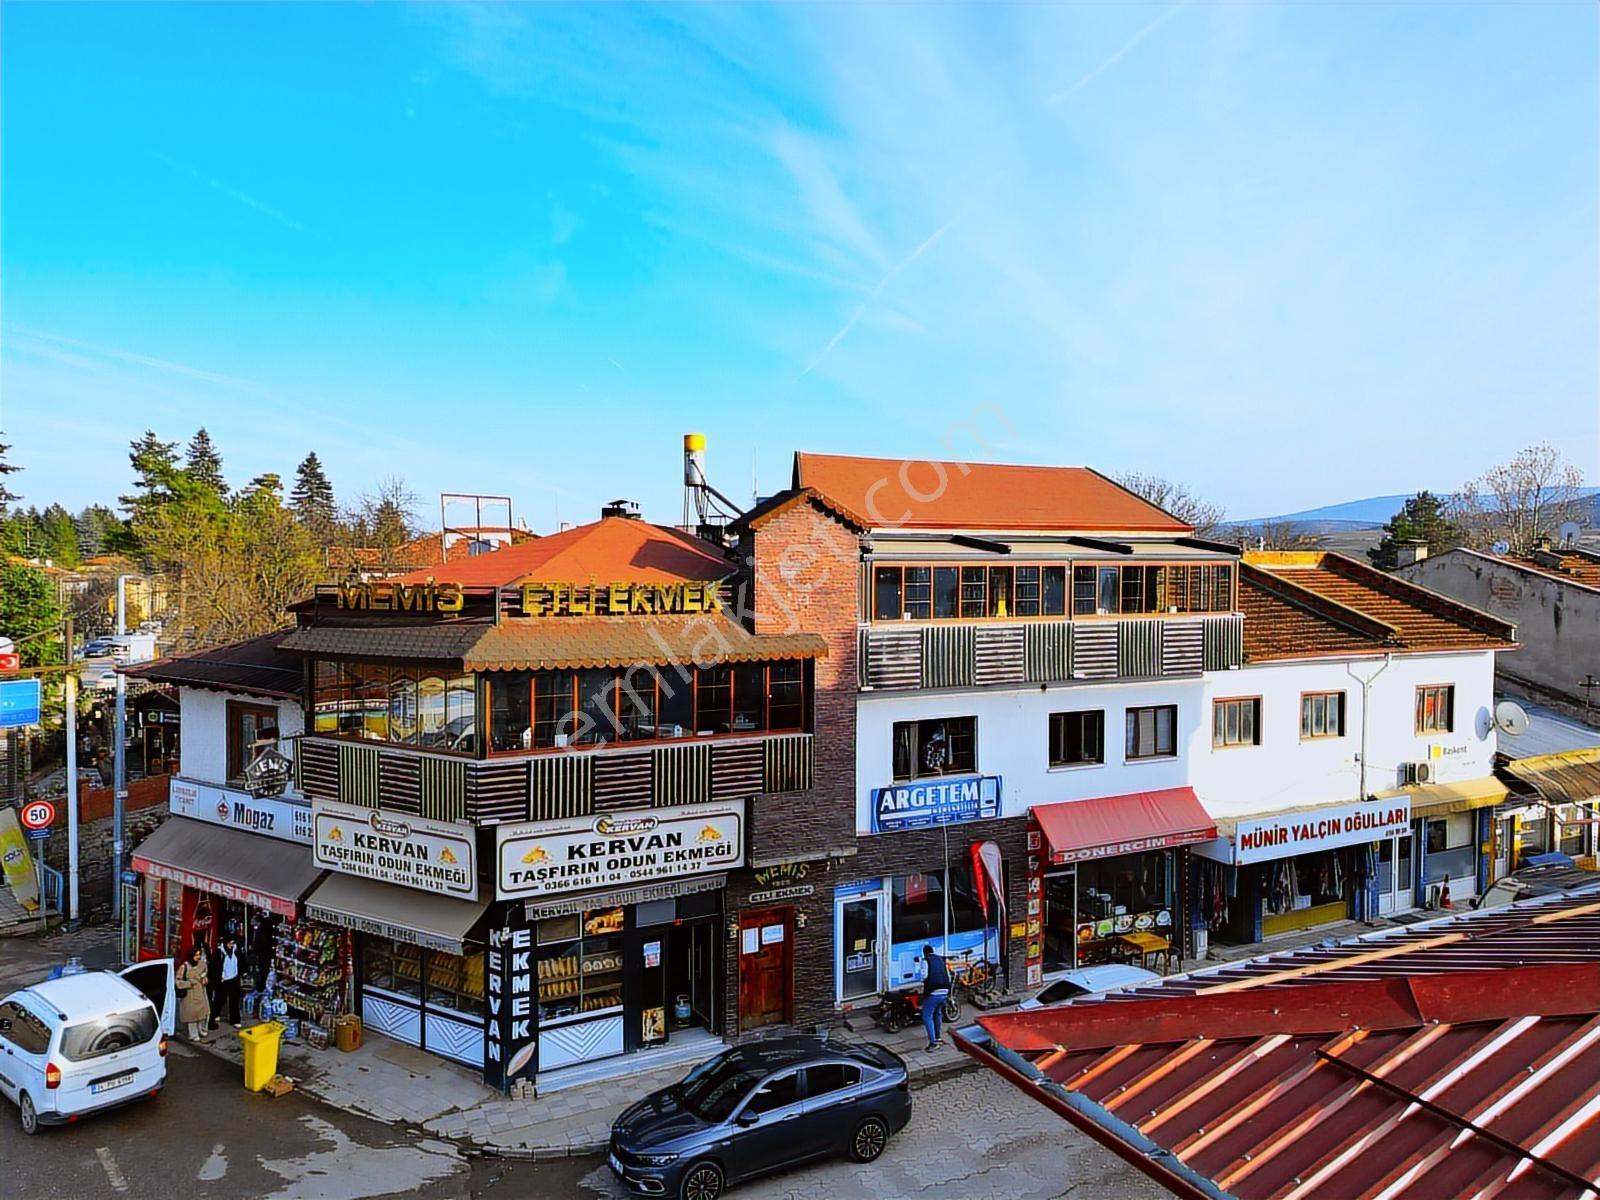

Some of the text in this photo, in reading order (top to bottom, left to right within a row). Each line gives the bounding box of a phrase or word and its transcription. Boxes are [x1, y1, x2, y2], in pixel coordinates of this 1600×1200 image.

[608, 580, 724, 614] EKMEK
[880, 781, 979, 811] ARGETEM
[30, 808, 47, 822] 50
[234, 802, 275, 830] Mogaz
[1241, 824, 1288, 851] MÜNİR
[1291, 818, 1341, 842] YALÇIN
[1345, 807, 1408, 832] OĞULLARI
[354, 832, 428, 861] KERVAN
[567, 832, 682, 861] KERVAN
[321, 844, 466, 885] TAŞFIRIN ODUN EKMEĞİ
[509, 840, 732, 885] TAŞFIRIN ODUN EKMEĞİ
[545, 878, 570, 891] 0366
[573, 875, 592, 887] 616
[595, 875, 606, 884] 11
[609, 872, 621, 882] 04
[630, 867, 654, 879] 0544
[656, 865, 673, 876] 961
[676, 863, 688, 873] 14
[690, 861, 702, 872] 37
[533, 902, 578, 919] KERVAN
[608, 892, 639, 906] ODUN
[489, 928, 501, 1062] KERVAN
[512, 928, 531, 1041] EKMEK
